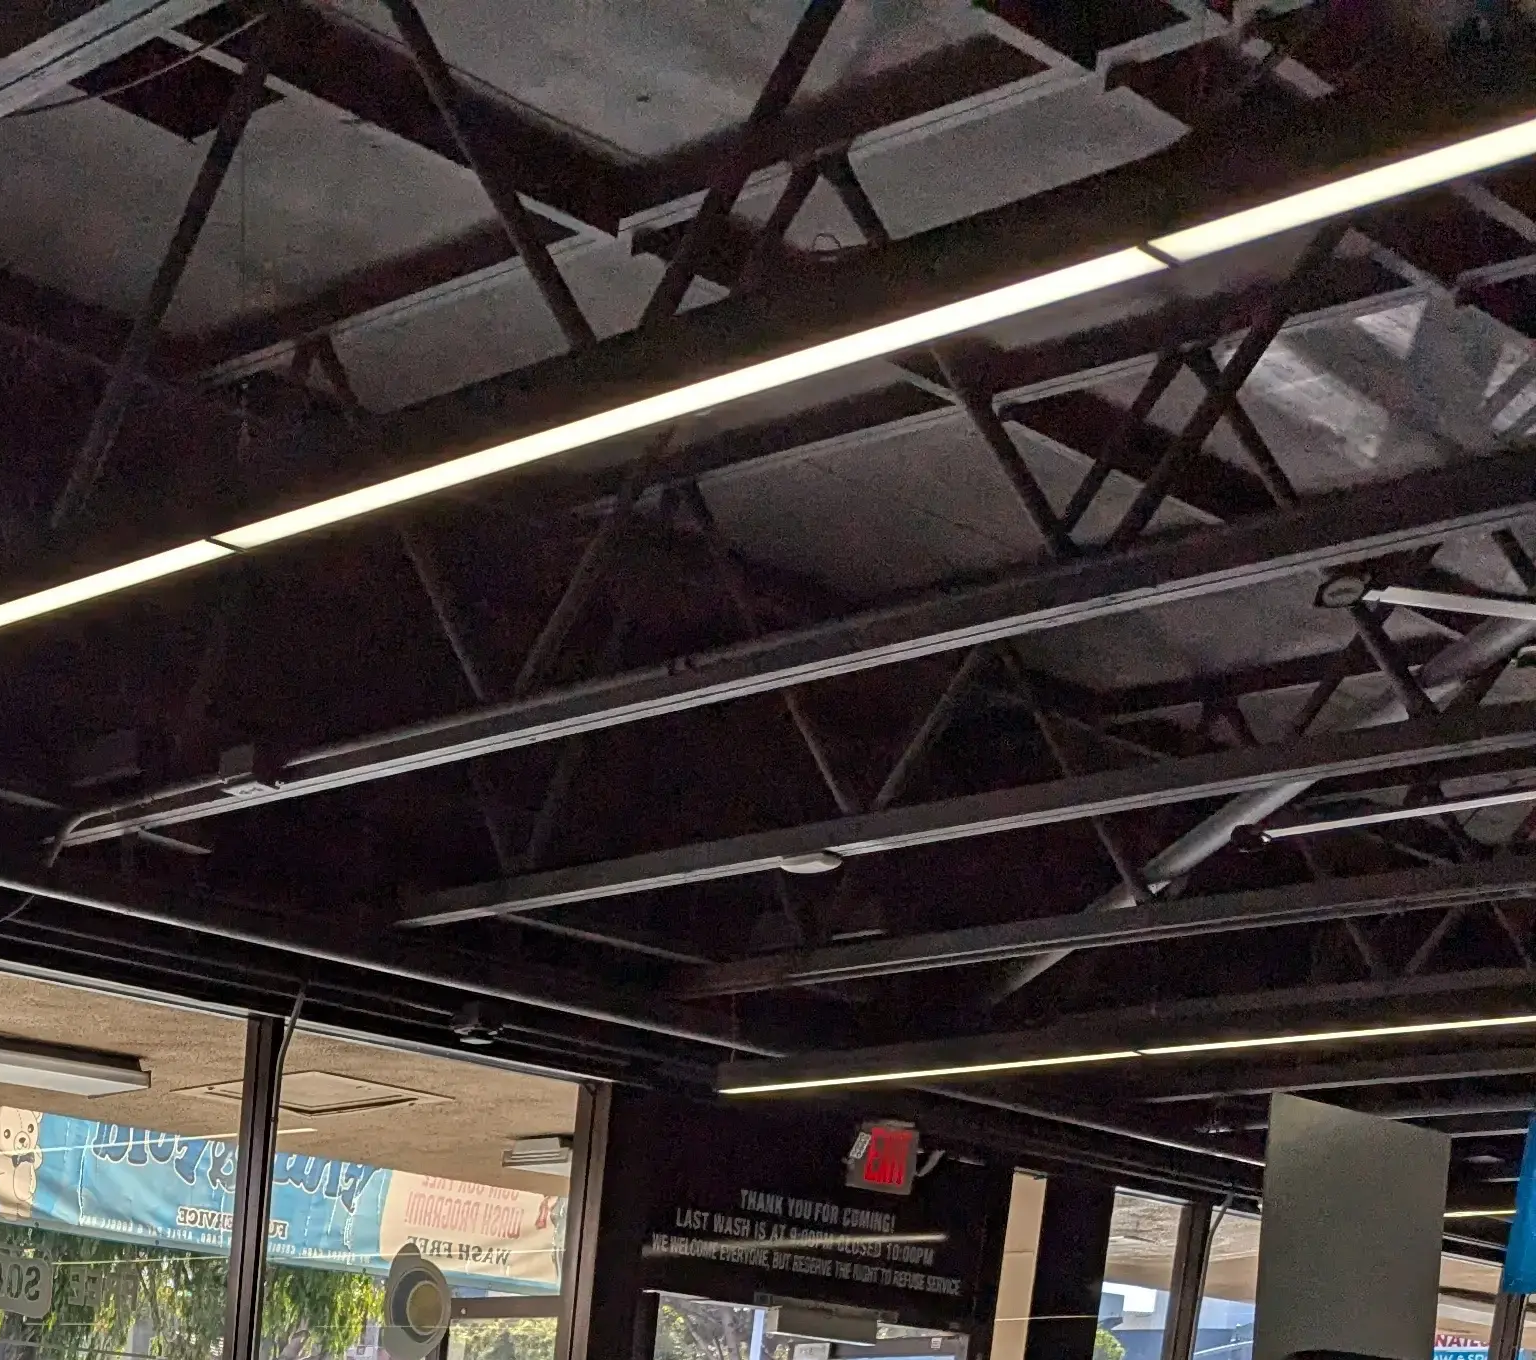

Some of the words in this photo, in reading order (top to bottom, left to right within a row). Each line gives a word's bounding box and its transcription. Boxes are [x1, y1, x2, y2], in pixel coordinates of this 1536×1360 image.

[864, 1127, 913, 1186] EXIT
[675, 1208, 710, 1231] LAST
[713, 1214, 751, 1238] WASH
[755, 1220, 766, 1241] IS
[768, 1223, 787, 1242] AT
[886, 1242, 936, 1266] 10:00PM
[740, 1188, 784, 1214] THANK
[787, 1197, 812, 1220] YOU
[814, 1202, 839, 1224] FOR
[842, 1207, 896, 1233] COMING!
[651, 1231, 668, 1251] WE
[670, 1234, 719, 1261] WELCOME
[772, 1251, 791, 1271] BUT
[792, 1254, 832, 1277] RESERVE
[835, 1259, 852, 1279] THE
[880, 1265, 892, 1285] TO
